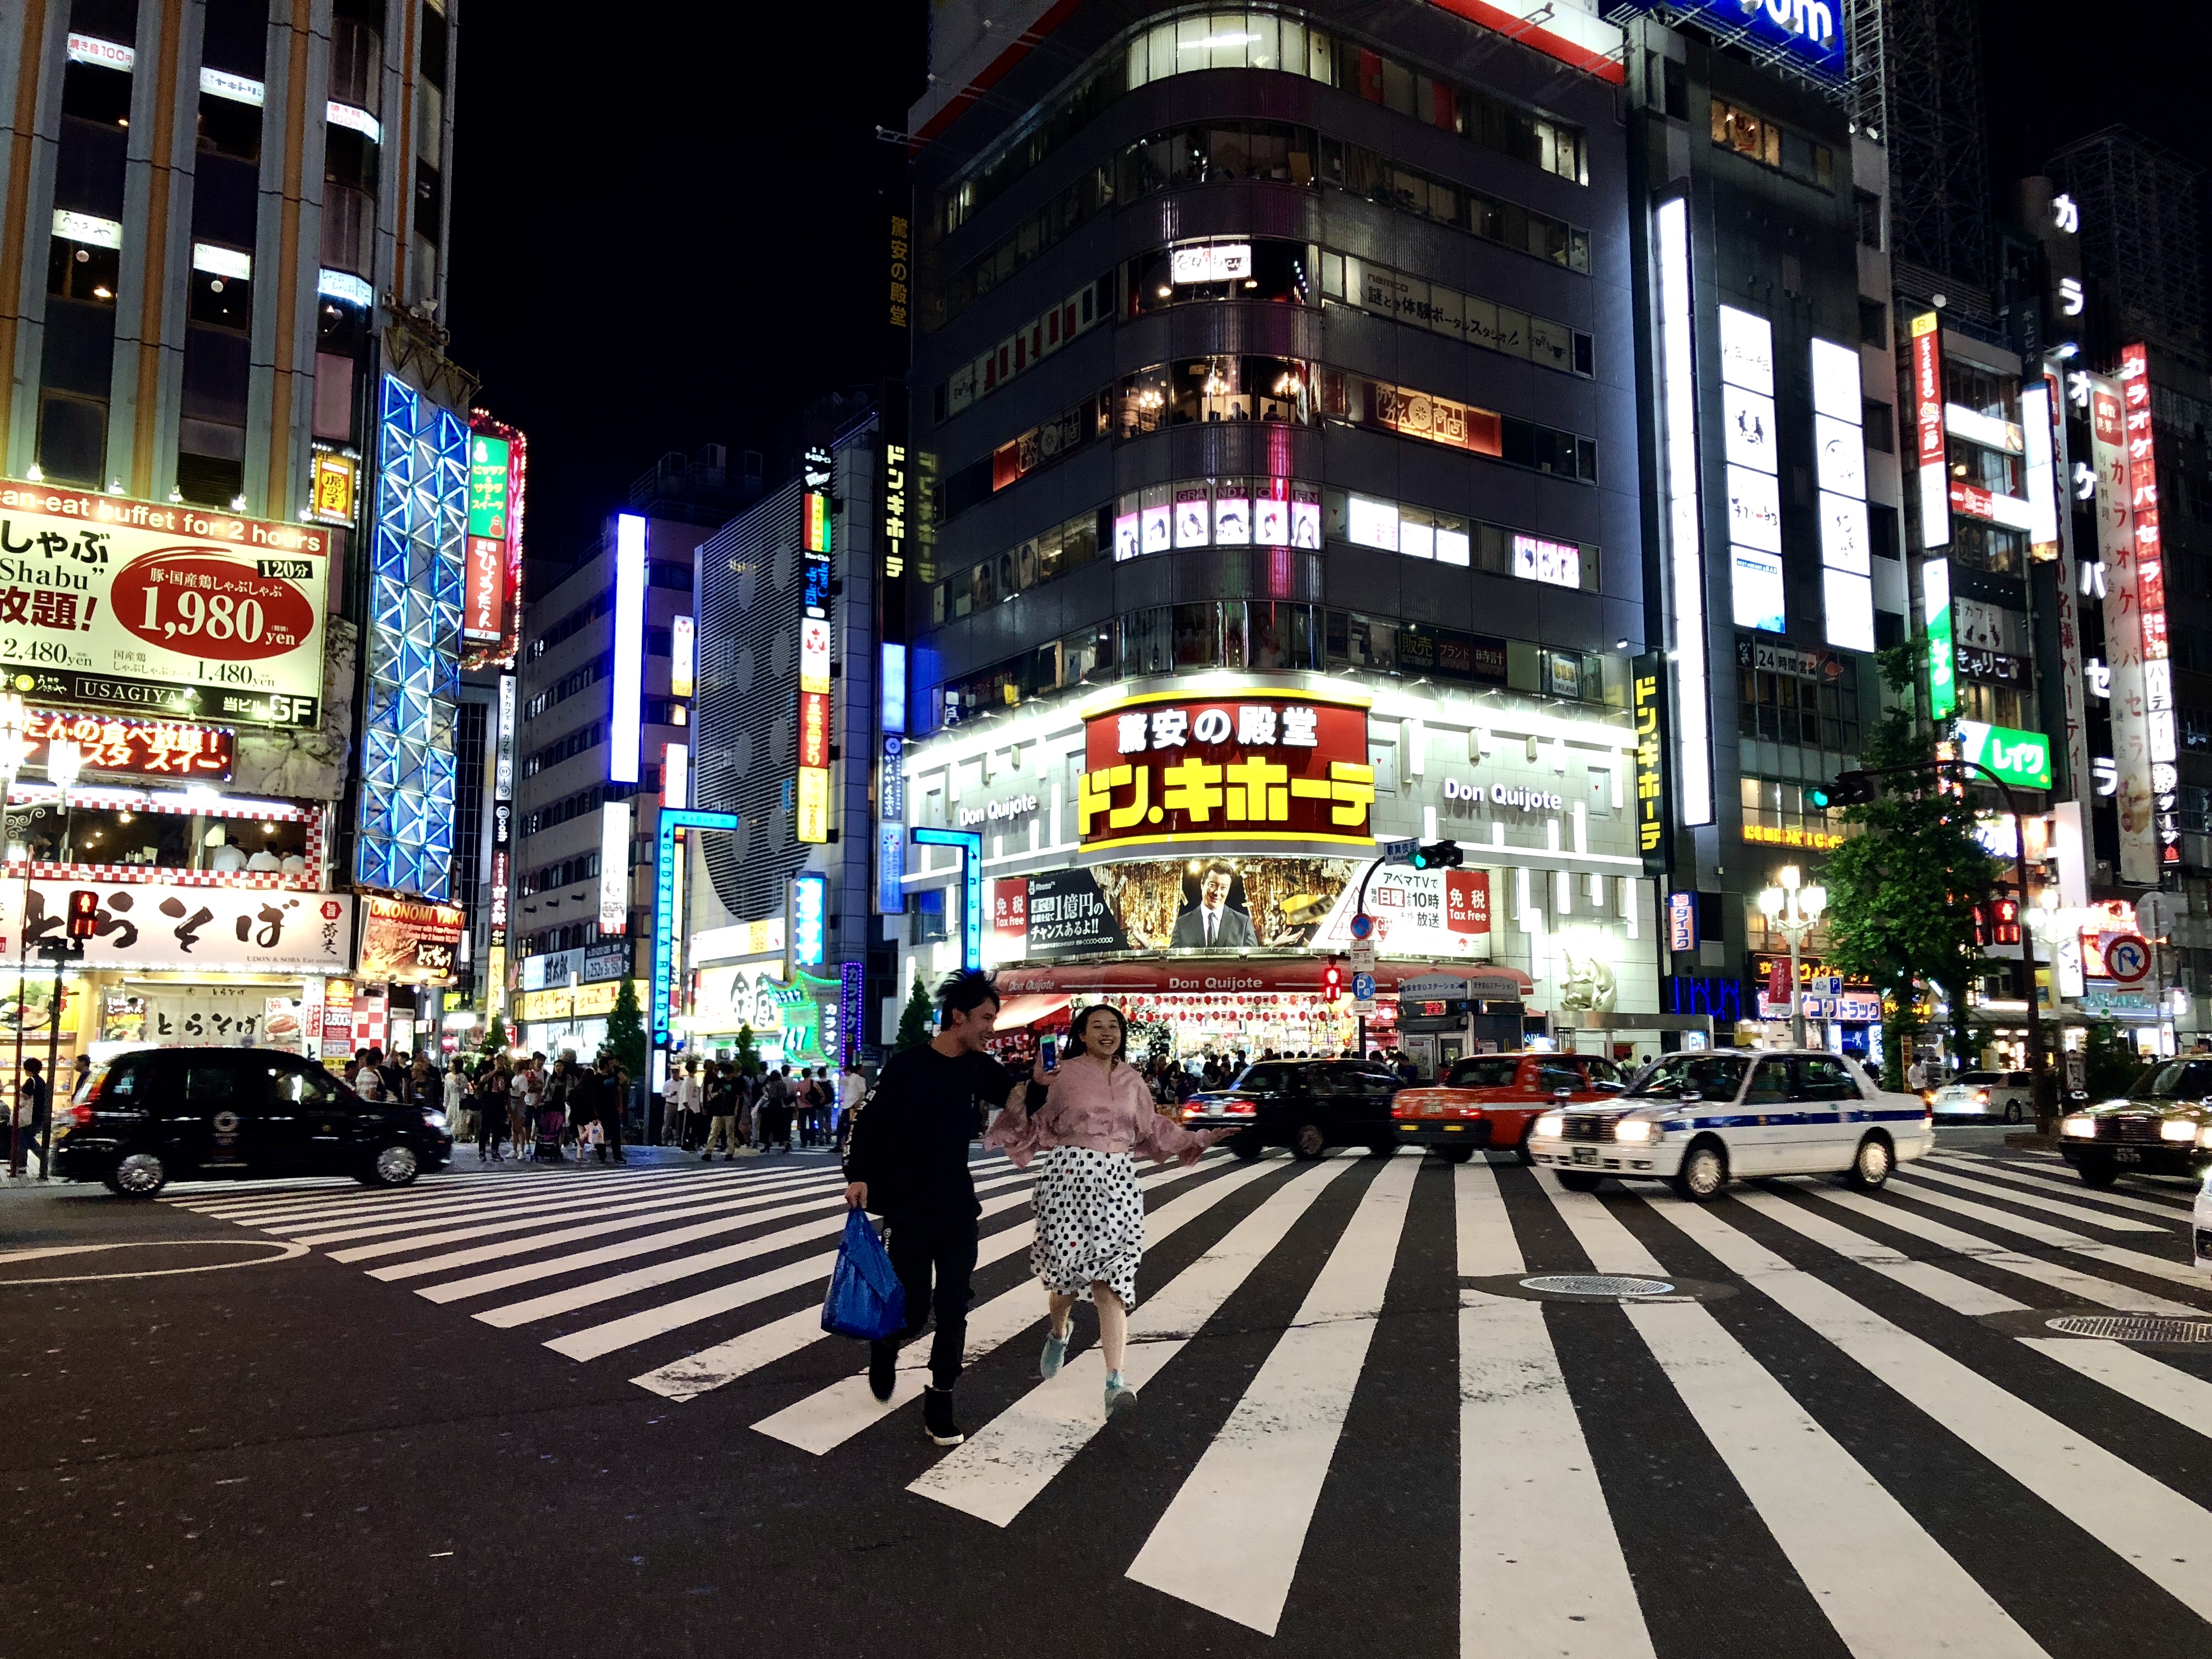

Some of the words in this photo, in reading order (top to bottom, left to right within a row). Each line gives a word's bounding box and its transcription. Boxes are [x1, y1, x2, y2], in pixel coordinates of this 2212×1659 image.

[70, 38, 132, 63] 焼き鳥100円
[890, 216, 907, 328] 驚安の殿堂
[1368, 273, 1409, 293] namco
[2123, 358, 2151, 458] カラオケ
[325, 475, 343, 504] 虎の子
[0, 489, 89, 517] an-eat
[98, 504, 175, 531] buffet
[184, 514, 219, 535] for
[228, 521, 245, 541] 2
[252, 525, 320, 552] hours
[1, 520, 110, 563] しゃぶ
[262, 561, 309, 577] 120分
[475, 550, 494, 628] ひょうたん
[138, 586, 263, 643] 1,980
[266, 631, 295, 646] yen
[1402, 633, 1432, 657] 販売
[1440, 644, 1469, 657] ブランド
[3, 638, 67, 664] 2,480
[67, 654, 92, 667] yen
[1476, 649, 1504, 665] 時計
[197, 661, 253, 685] 1,480
[252, 678, 275, 687] yen
[84, 681, 178, 706] USAGIYA
[504, 680, 512, 721] ネットカフェ
[1116, 705, 1319, 754] 驚安の殿堂
[1444, 778, 1484, 801] Don
[1491, 782, 1562, 812] Quijote
[960, 807, 985, 827] Don
[988, 792, 1037, 821] Quijote
[1383, 872, 1438, 889] アベマTVで
[659, 842, 672, 947] GODZILLA
[997, 895, 1024, 916] 免税
[1055, 892, 1104, 921] 1億円の
[1371, 888, 1377, 904] 毎週
[1380, 889, 1404, 906] 日曜
[1412, 893, 1439, 909] 10時
[1449, 888, 1486, 909] 免税
[326, 903, 337, 917] 旨
[372, 900, 433, 922] OKONOMI
[437, 907, 465, 925] YAKI
[996, 917, 1008, 927] Tax
[1009, 916, 1024, 926] Free
[1417, 912, 1440, 928] 放送
[1449, 909, 1465, 920] Tax
[1468, 910, 1487, 922] Free
[1675, 908, 1690, 950] ダイコク
[658, 962, 669, 1011] ROAD
[1169, 978, 1202, 989] Don
[1208, 977, 1263, 991] Quijote
[1357, 980, 1365, 996] P
[1831, 979, 1838, 988] P
[775, 990, 800, 1003] カラオケ
[846, 968, 859, 1030] カラオケ
[158, 1012, 262, 1036] とらそば
[825, 1003, 838, 1056] カラオケ
